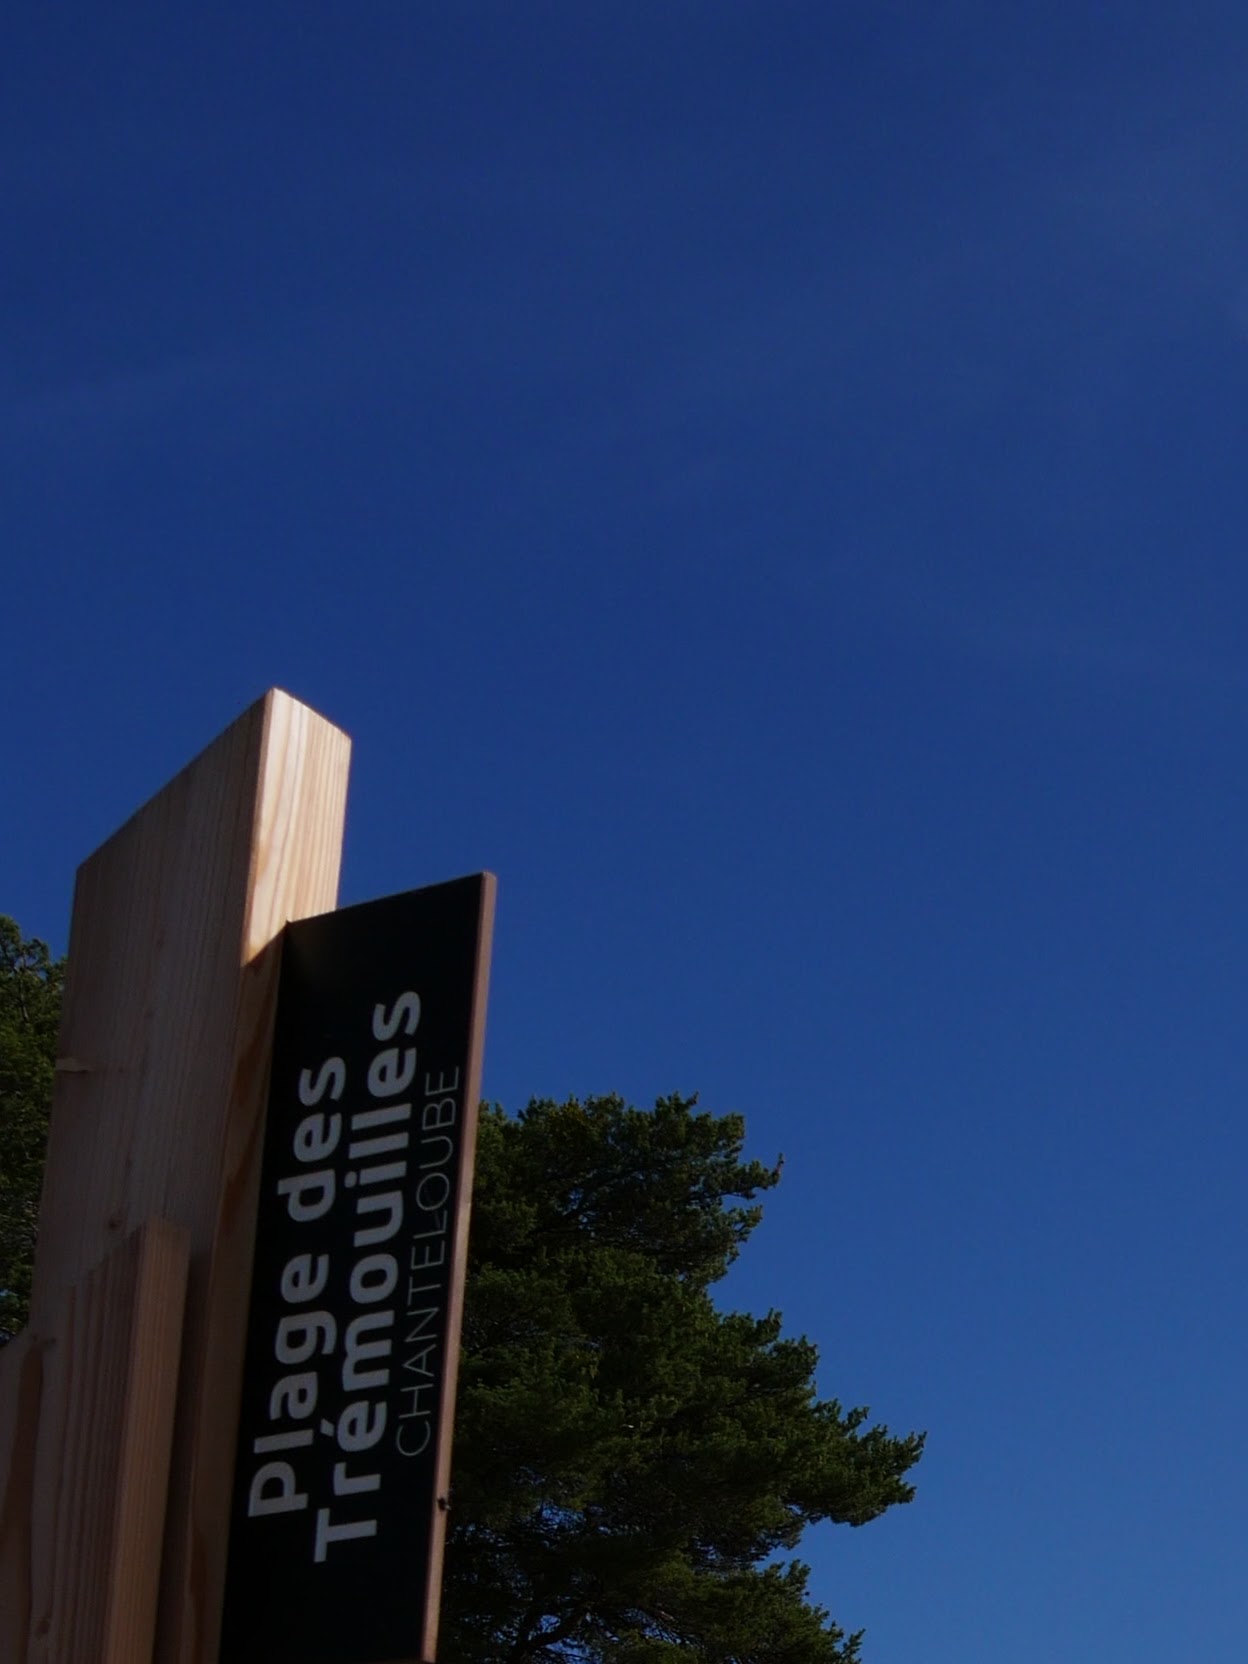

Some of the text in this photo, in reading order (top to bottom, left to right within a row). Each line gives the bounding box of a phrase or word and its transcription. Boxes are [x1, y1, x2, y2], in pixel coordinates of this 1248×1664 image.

[248, 1055, 347, 1518] Plage des
[314, 990, 421, 1563] Trémouilles
[397, 1064, 460, 1458] CHANTELOUBE
